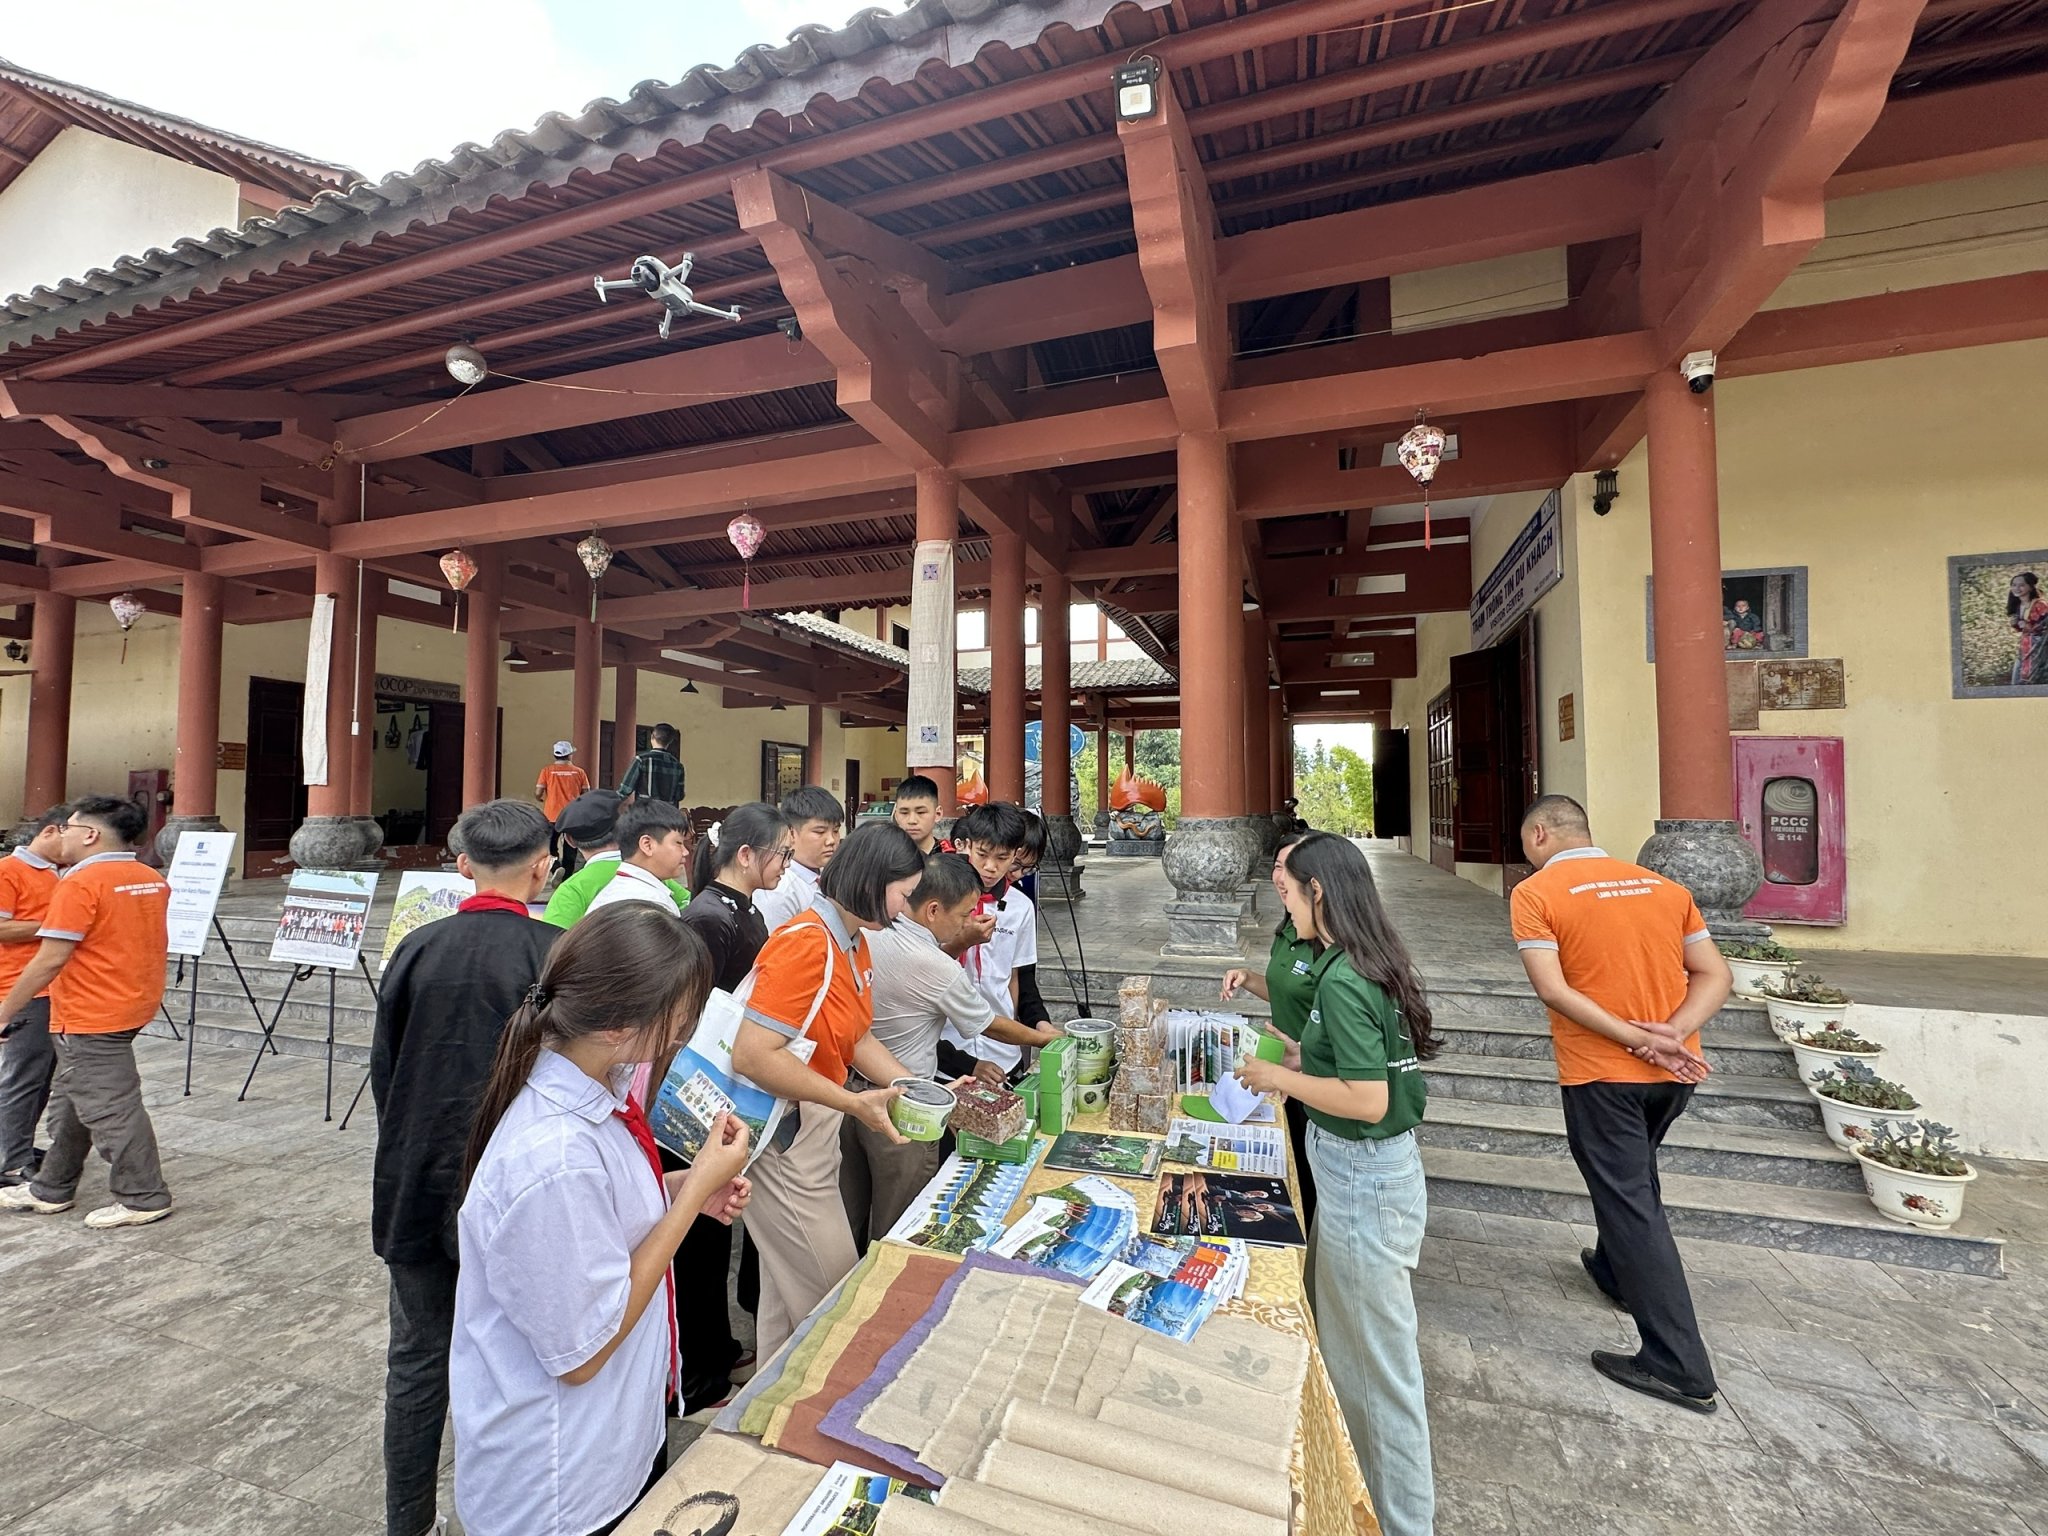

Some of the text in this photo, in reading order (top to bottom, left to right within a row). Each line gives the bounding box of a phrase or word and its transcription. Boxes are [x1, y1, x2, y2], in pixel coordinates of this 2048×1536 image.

[1504, 577, 1514, 600] TIN
[1515, 563, 1525, 586] DU
[1526, 526, 1553, 573] KHÁCH
[1505, 588, 1524, 613] CENTER
[380, 677, 413, 692] OCOP
[1771, 816, 1808, 826] PCCC
